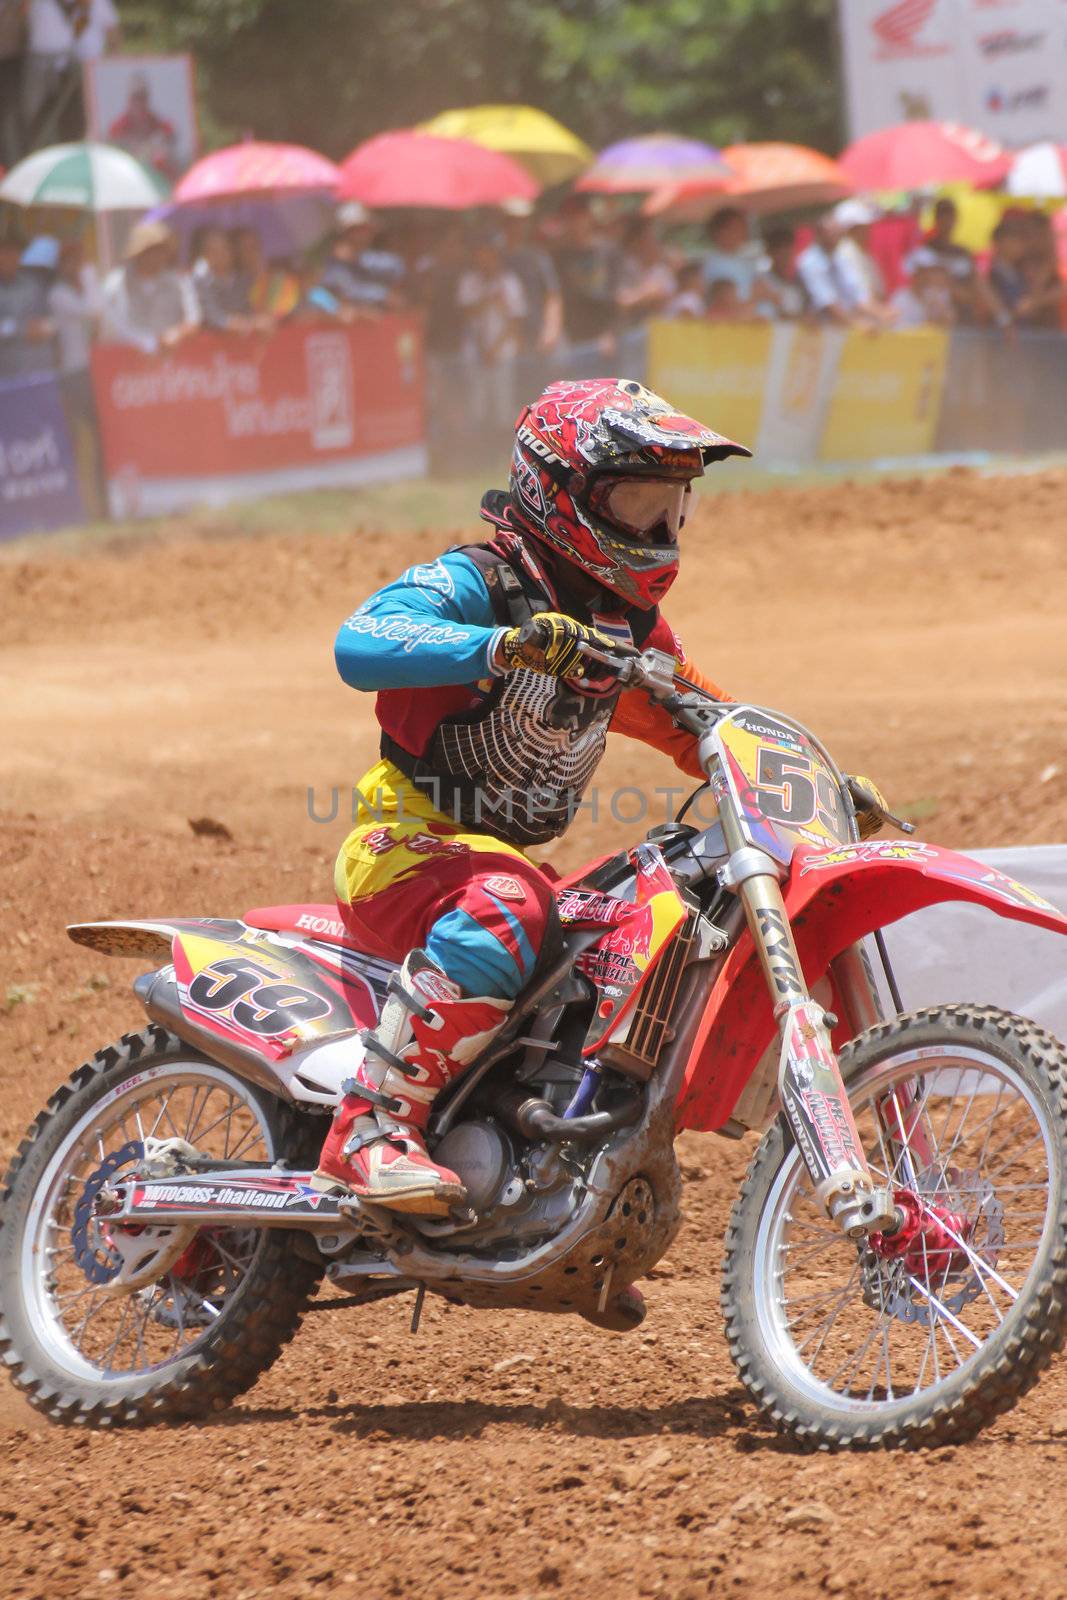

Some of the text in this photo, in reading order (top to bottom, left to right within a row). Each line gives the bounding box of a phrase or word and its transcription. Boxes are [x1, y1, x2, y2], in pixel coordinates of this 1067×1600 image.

[517, 424, 570, 469] thor
[745, 722, 797, 742] HONDA
[295, 913, 352, 940] HON
[755, 908, 802, 993] KYB
[188, 957, 333, 1037] 59
[788, 1096, 820, 1180] DUNLOP
